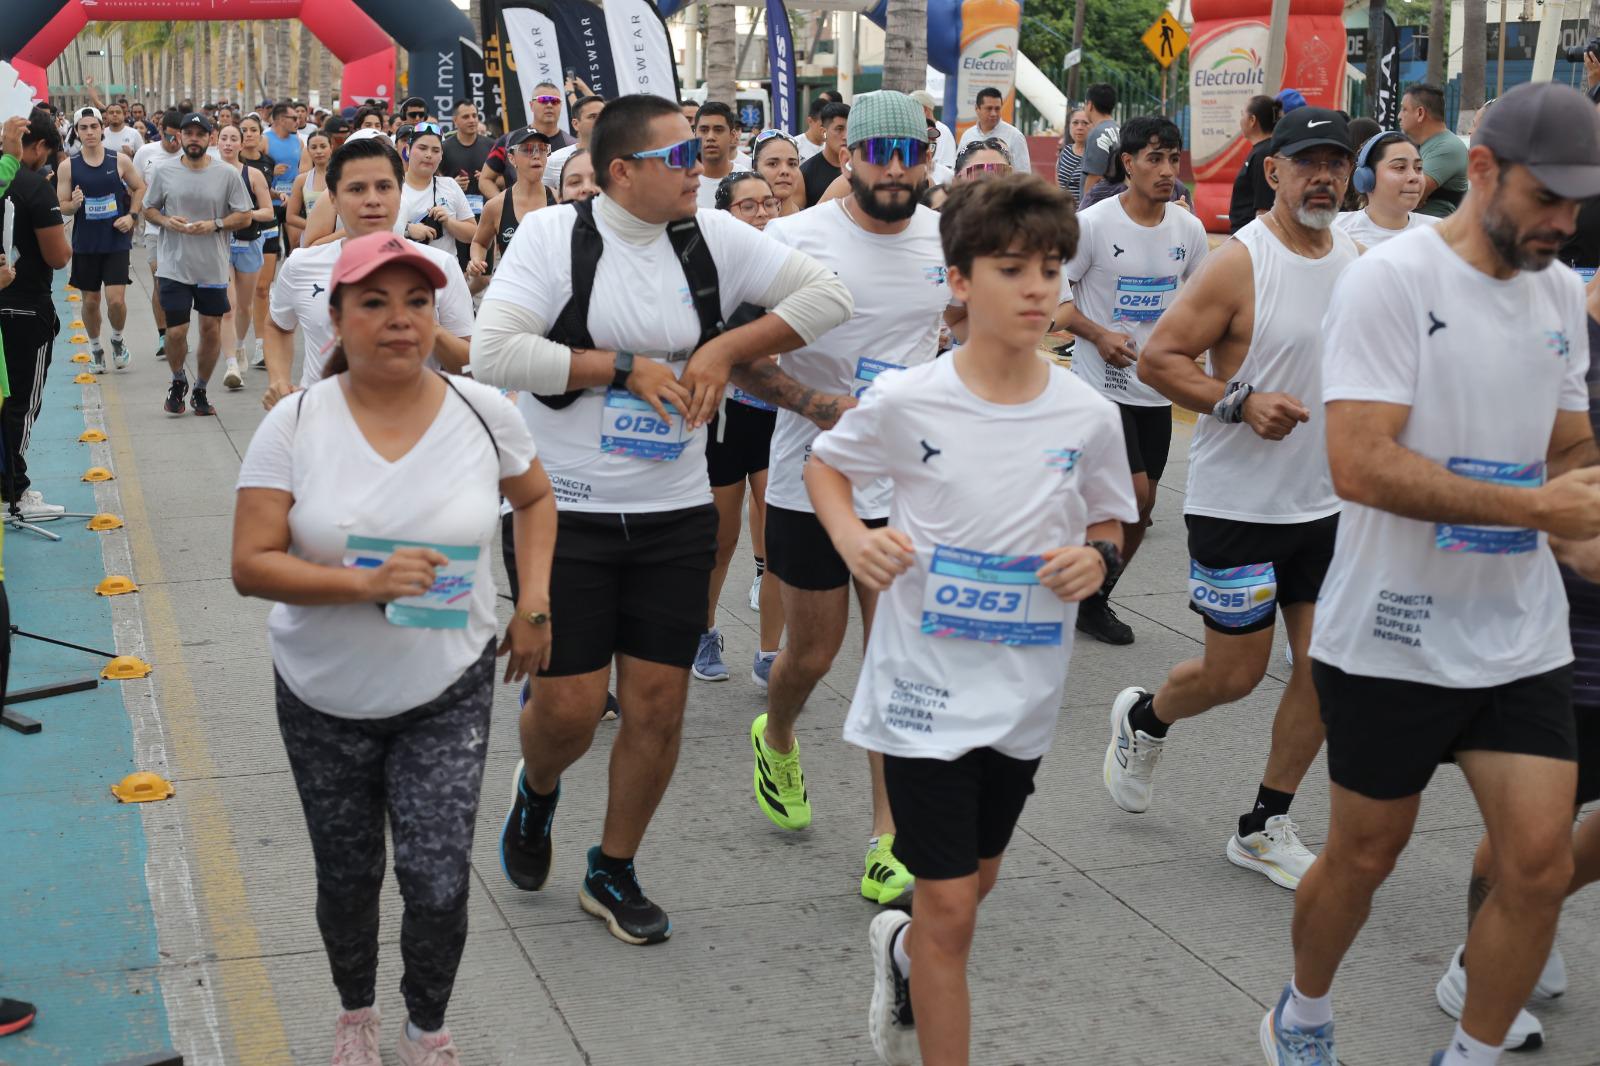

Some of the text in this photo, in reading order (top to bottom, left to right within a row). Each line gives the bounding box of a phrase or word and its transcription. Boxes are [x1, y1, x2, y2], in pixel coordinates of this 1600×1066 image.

[581, 17, 603, 95] RTSWEAR
[1195, 68, 1264, 87] Electrolit
[1120, 295, 1160, 306] 0245
[935, 584, 1022, 613] 0363
[1193, 586, 1245, 607] 0095
[1379, 590, 1433, 605] CONECTA
[1376, 616, 1422, 633] SUPERA
[888, 703, 933, 720] SUPERA
